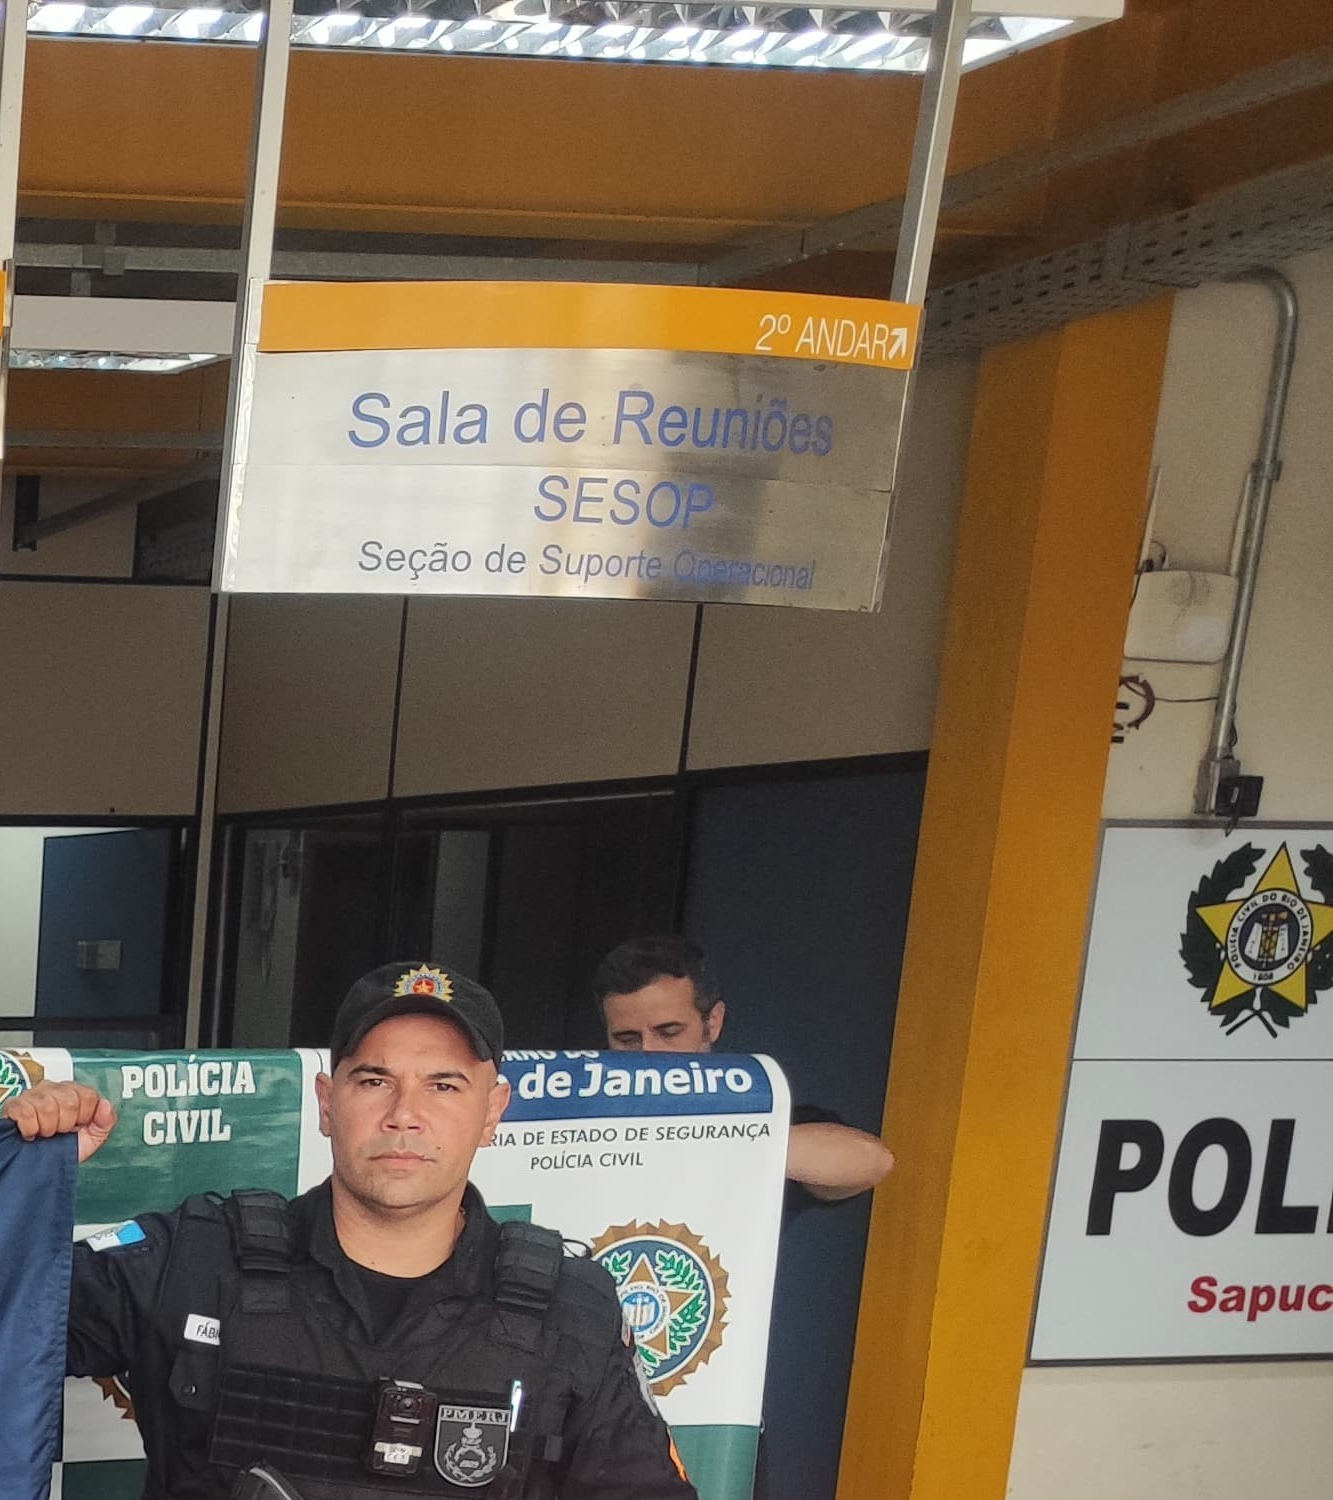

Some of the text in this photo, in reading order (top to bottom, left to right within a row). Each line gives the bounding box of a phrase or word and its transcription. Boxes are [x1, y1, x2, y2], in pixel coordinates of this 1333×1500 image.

[754, 313, 890, 362] 2º ANDAR
[347, 387, 835, 457] Sala de Reuniões
[532, 474, 716, 531] SESOP
[356, 539, 817, 591] Seção de Suporte Operacional
[120, 1054, 257, 1100] POLÍCIA
[517, 1061, 754, 1100] de Janeiro
[142, 1107, 232, 1147] CIVIL
[523, 1130, 546, 1146] DE
[550, 1127, 618, 1145] ESTADO
[624, 1126, 650, 1142] DE
[655, 1123, 772, 1143] SEGURANÇA
[529, 1150, 645, 1171] POLÍCIA CIVIL
[1086, 1116, 1333, 1238] POL
[442, 1407, 507, 1423] PMERJ
